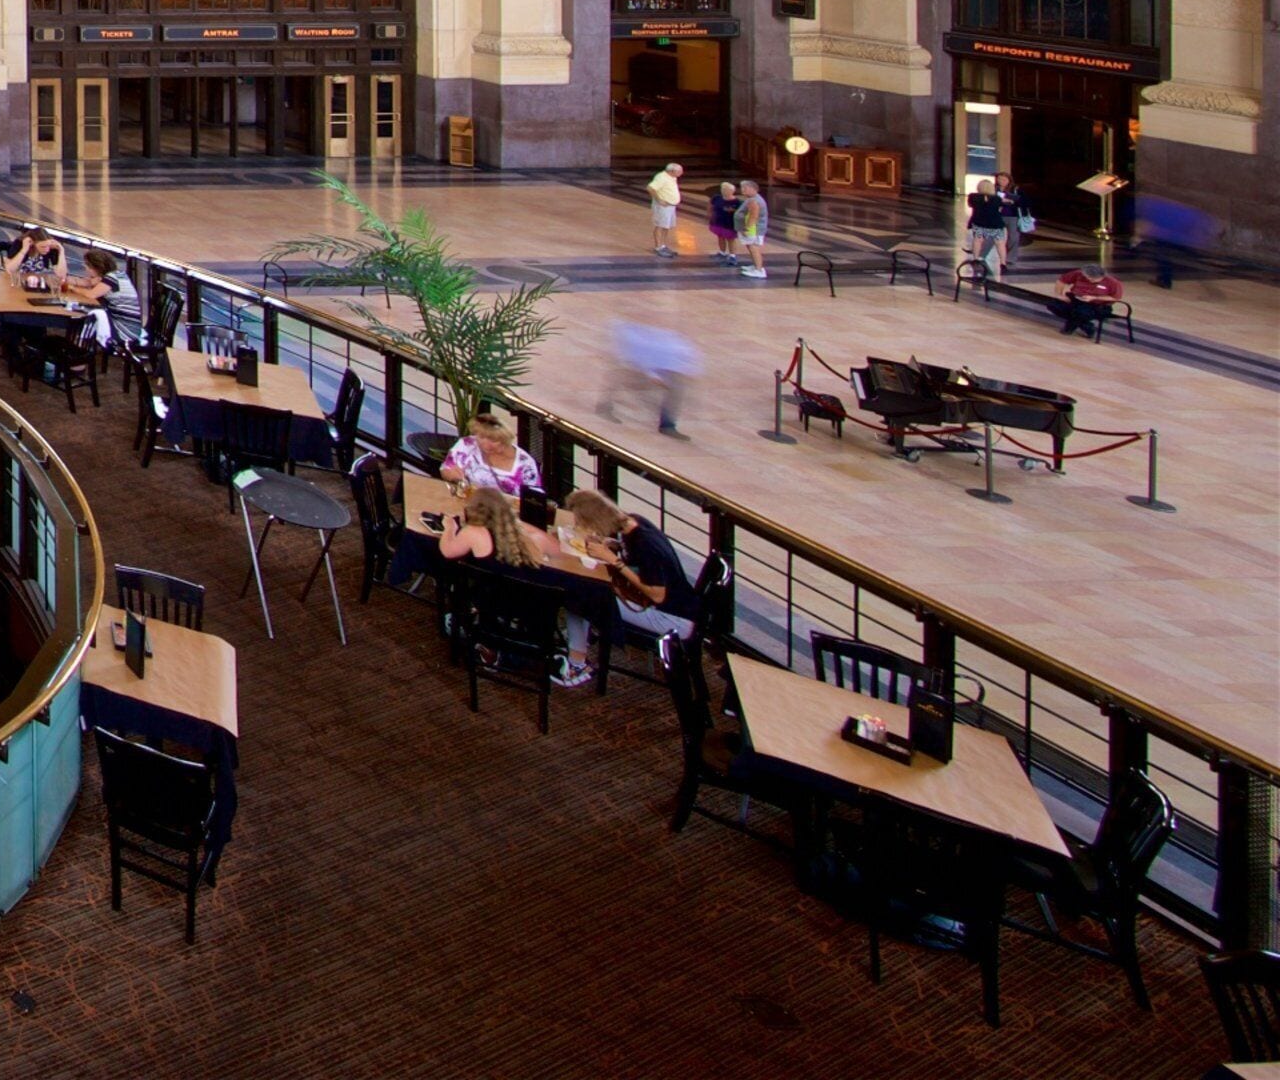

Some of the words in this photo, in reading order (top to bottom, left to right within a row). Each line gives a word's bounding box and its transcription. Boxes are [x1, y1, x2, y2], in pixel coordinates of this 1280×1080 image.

[100, 30, 134, 38] TICKETS
[203, 29, 239, 37] AMTRAK
[974, 42, 1041, 59] PIERPONTS
[1045, 51, 1132, 70] RESTAURANT
